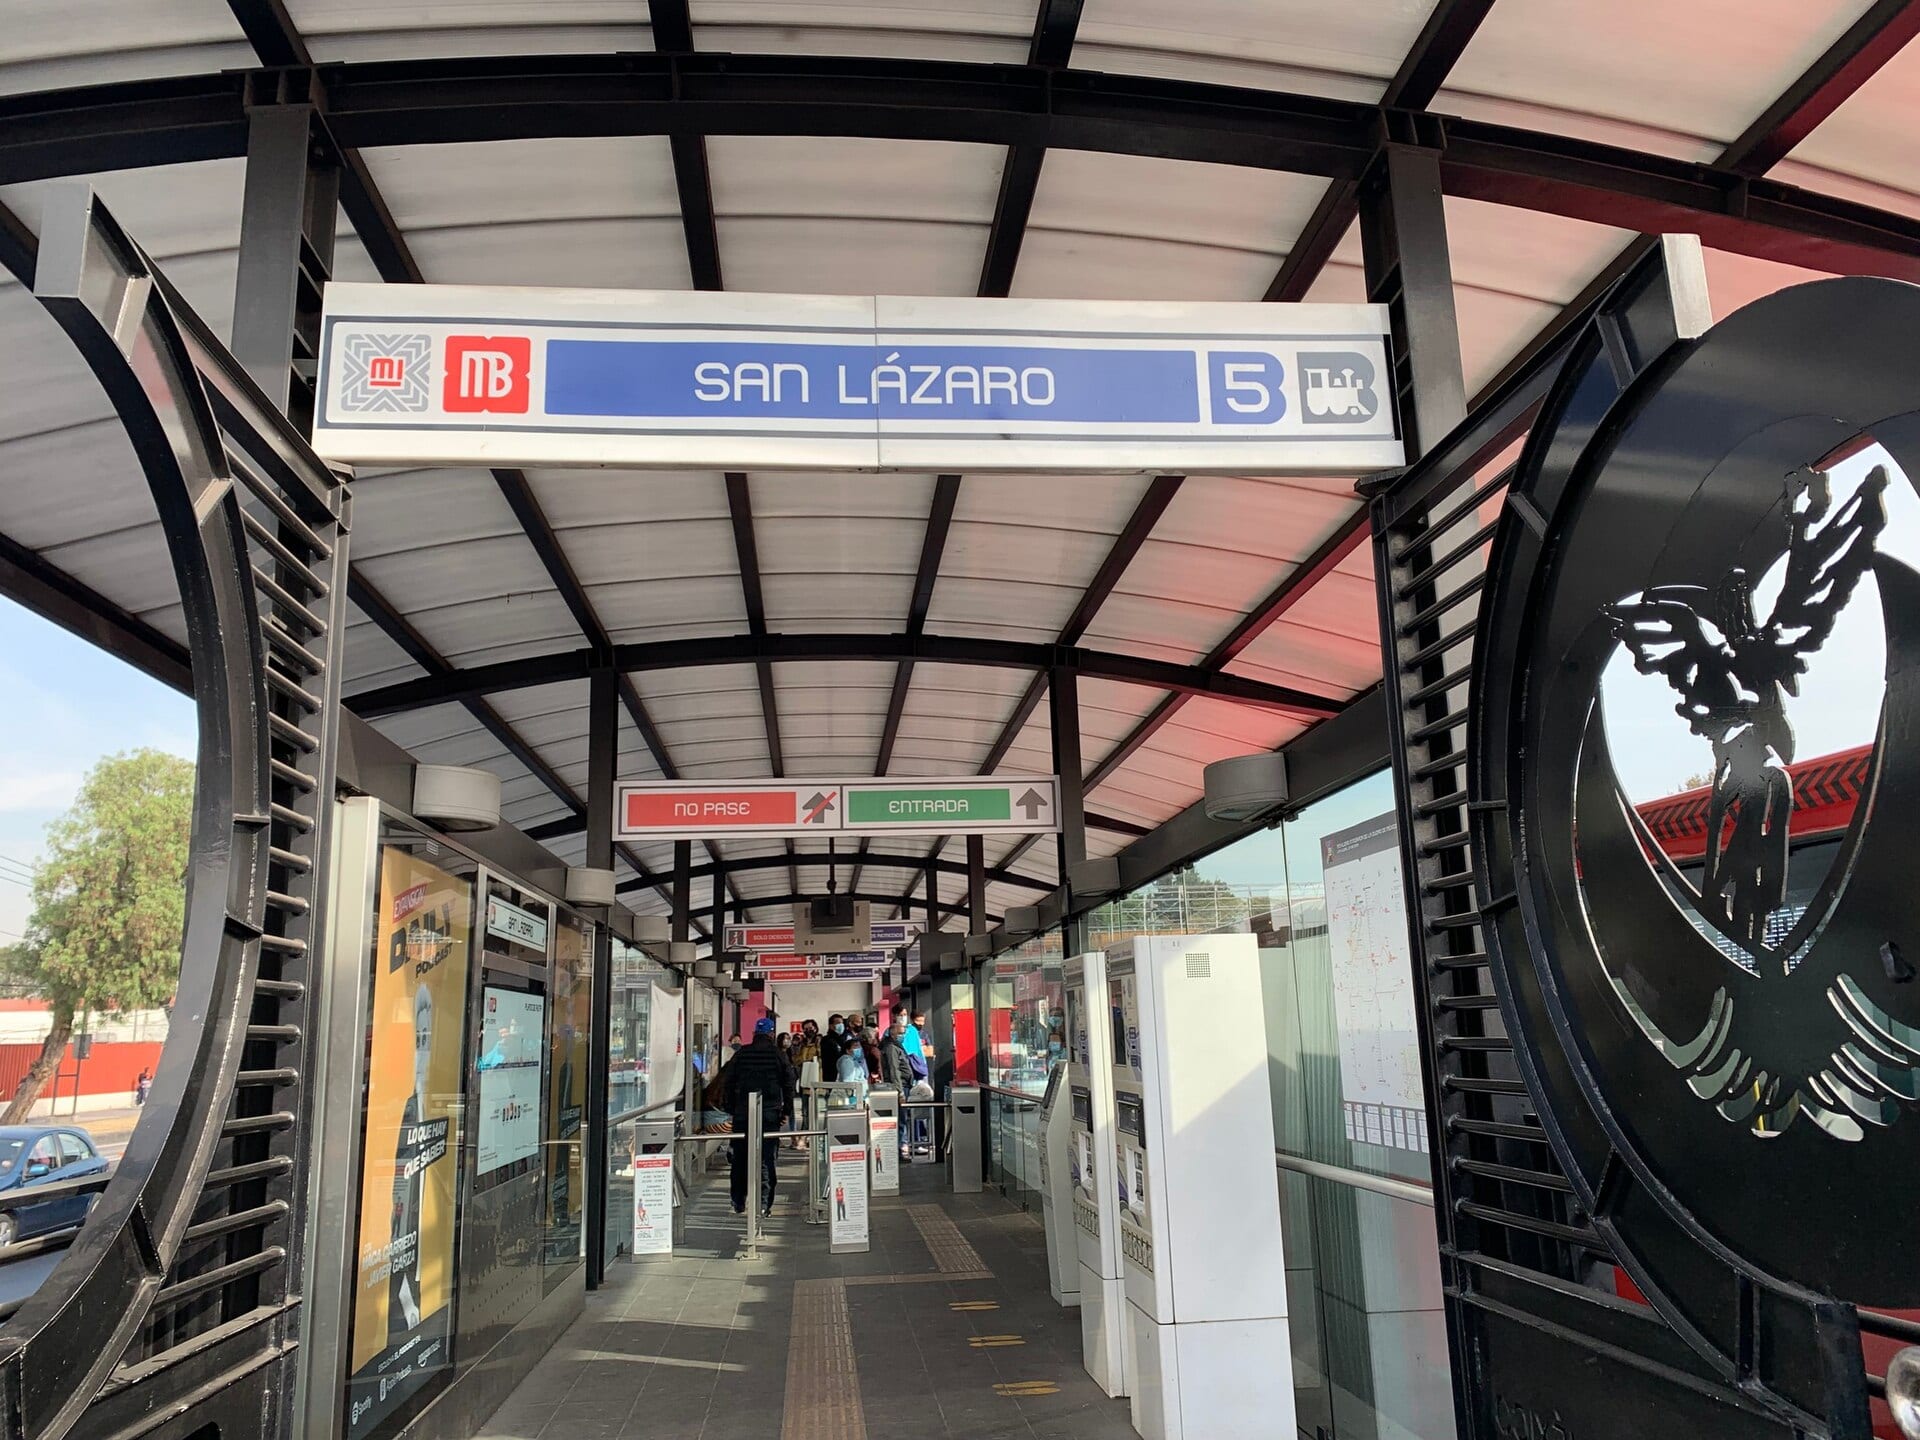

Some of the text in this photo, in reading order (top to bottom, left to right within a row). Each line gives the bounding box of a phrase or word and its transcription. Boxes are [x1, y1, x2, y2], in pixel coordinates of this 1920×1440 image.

[459, 350, 513, 398] MB
[694, 351, 1055, 406] SAN LÁZARO
[1225, 363, 1269, 412] 5
[674, 801, 751, 817] NO PASE
[888, 799, 969, 814] ENTRADA
[407, 1120, 448, 1145] LO QUE HAY
[404, 1139, 446, 1180] QUE SABER
